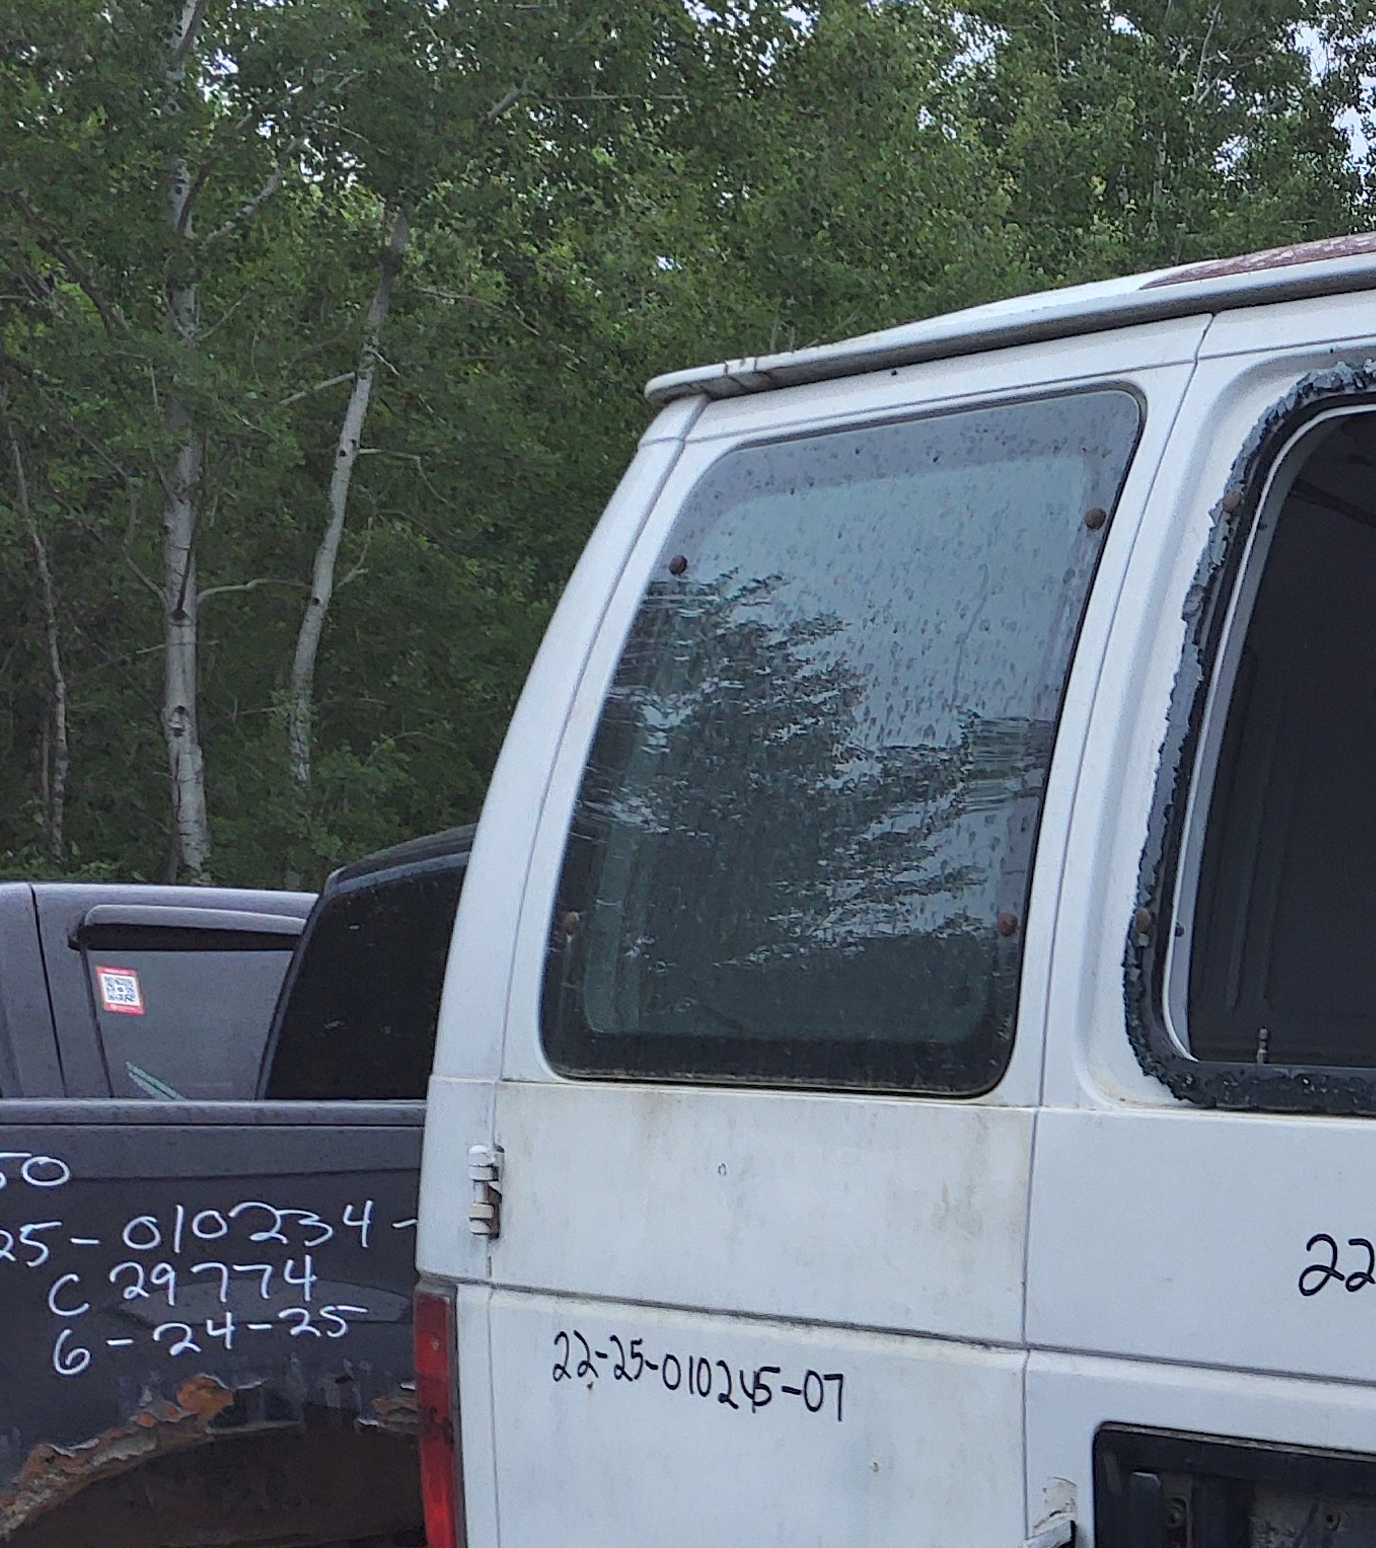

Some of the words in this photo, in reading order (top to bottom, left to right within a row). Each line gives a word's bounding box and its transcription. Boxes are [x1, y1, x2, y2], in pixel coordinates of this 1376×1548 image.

[47, 1273, 91, 1317] C
[108, 1254, 318, 1307] 29774
[52, 1304, 369, 1376] 6-24-25
[551, 1329, 844, 1422] 22-25-010245-07
